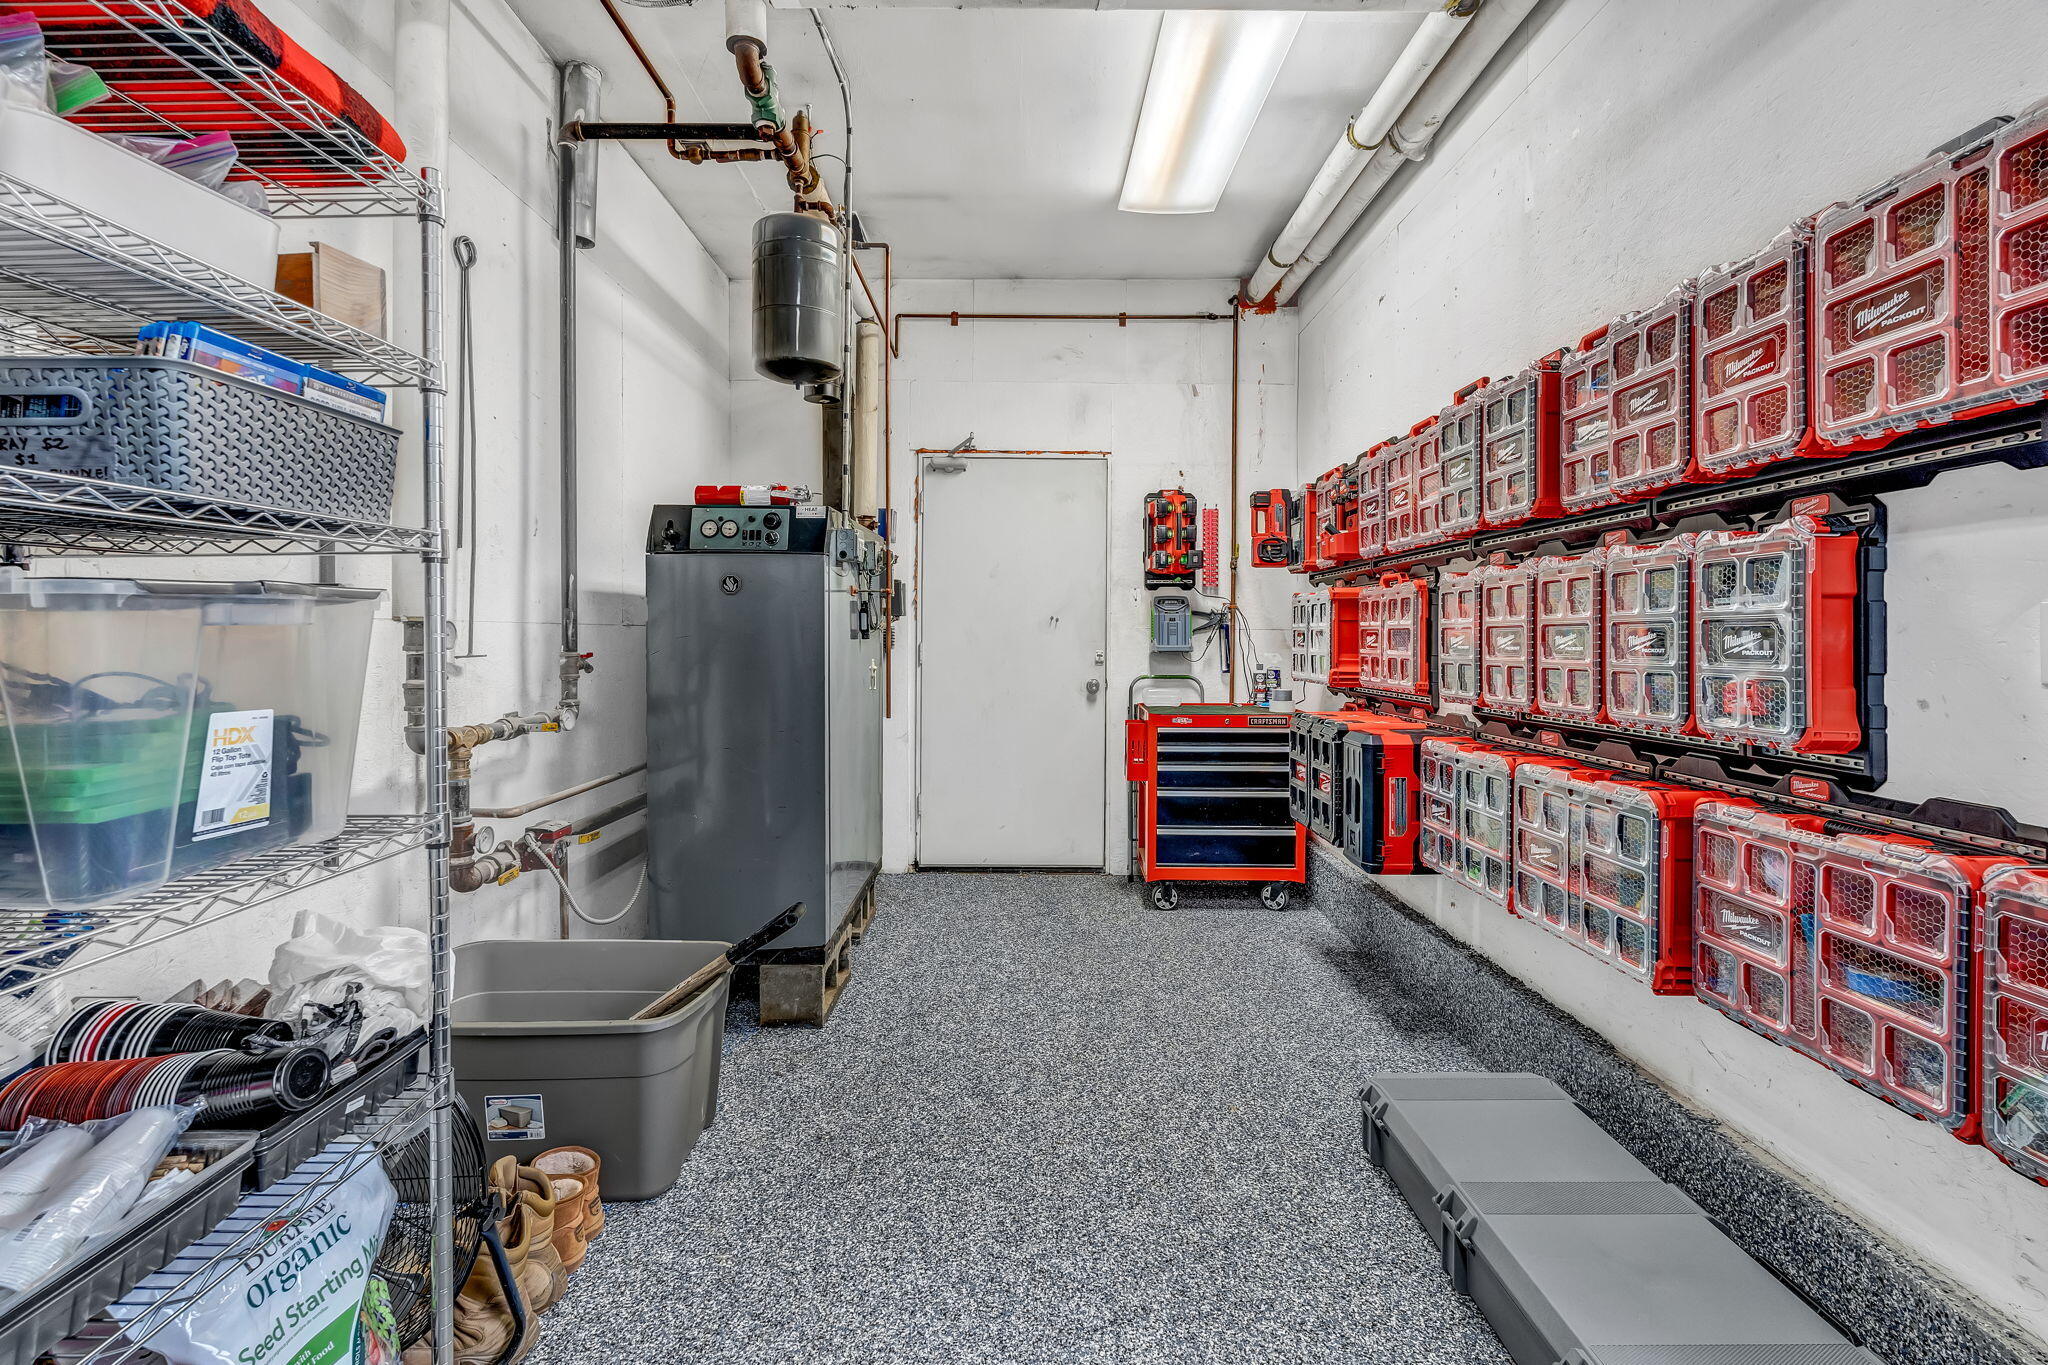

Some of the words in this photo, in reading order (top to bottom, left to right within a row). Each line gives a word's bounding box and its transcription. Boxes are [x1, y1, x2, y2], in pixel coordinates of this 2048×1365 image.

[1854, 290, 1911, 330] Milwaukee
[1880, 305, 1927, 328] PACKOUT
[41, 437, 70, 452] $2
[14, 452, 39, 467] $1
[1722, 630, 1763, 650] Milwaukee
[1250, 717, 1287, 725] CRAFTSMAN
[212, 726, 257, 747] HDX
[211, 755, 224, 764] Flip
[225, 753, 238, 762] Top
[238, 751, 252, 761] Tote
[212, 748, 221, 756] 12
[221, 745, 242, 756] Gallon
[1720, 908, 1761, 925] Milwaukee
[1739, 929, 1772, 947] PACKOUT
[246, 1213, 353, 1309] organic
[238, 1317, 286, 1365] Seed
[285, 1257, 365, 1328] Starting
[311, 1341, 336, 1365] Food
